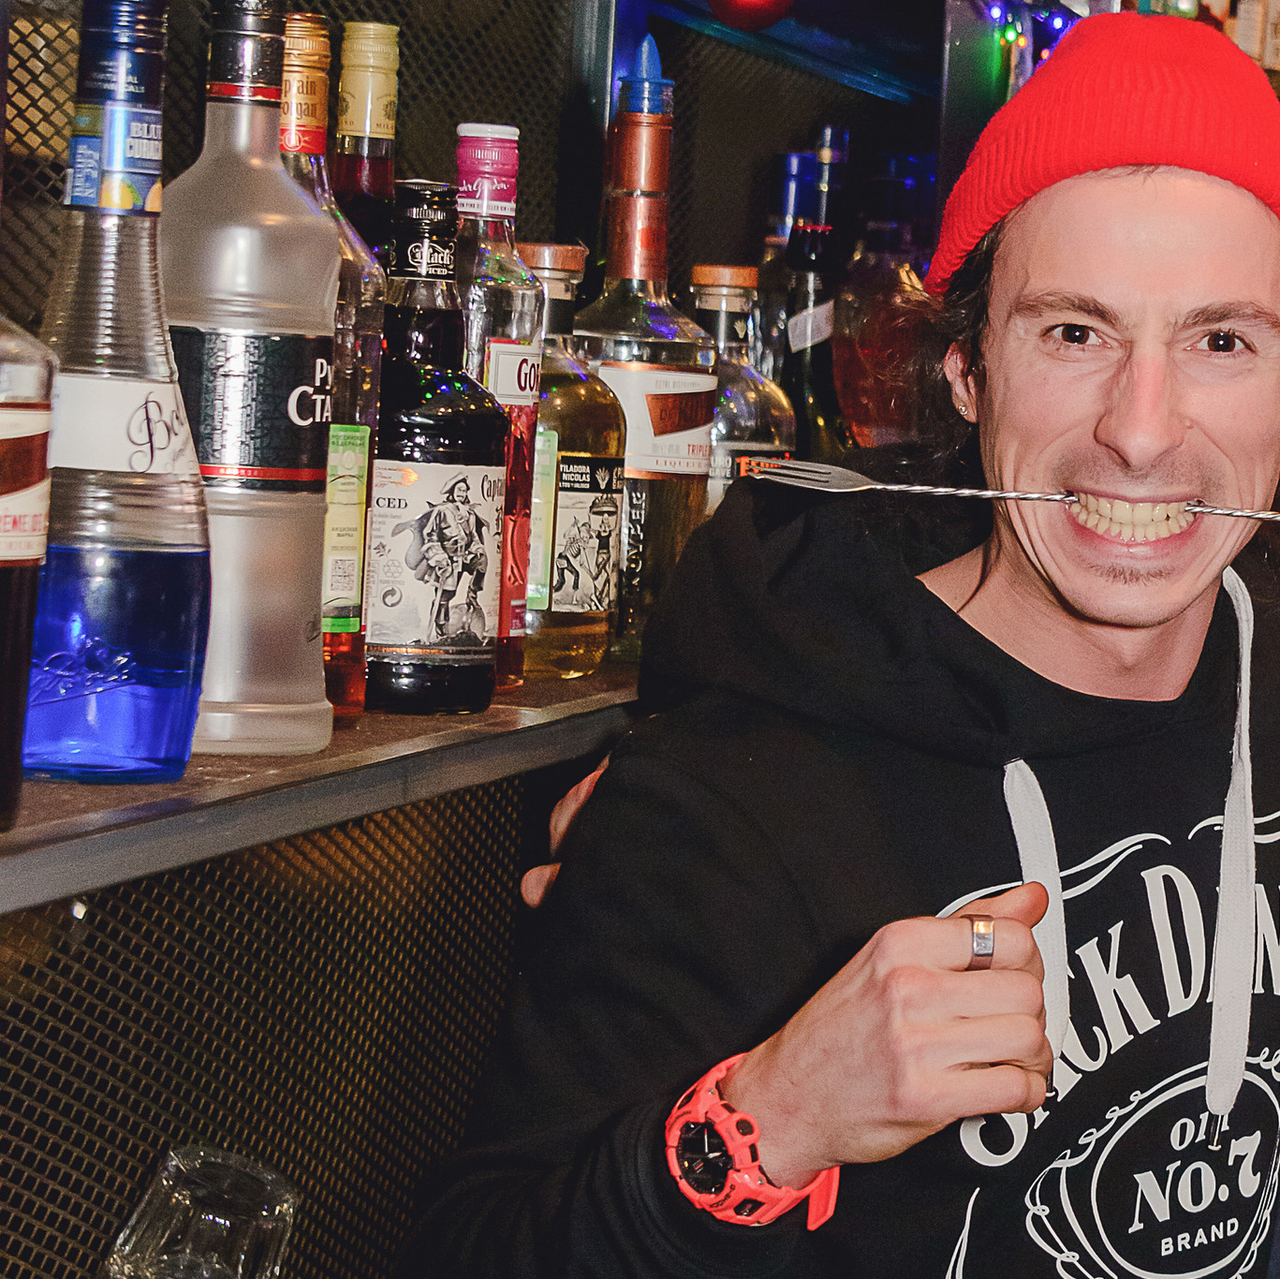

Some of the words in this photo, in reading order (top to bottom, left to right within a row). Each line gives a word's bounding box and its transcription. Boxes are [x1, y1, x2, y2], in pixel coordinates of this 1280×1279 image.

[473, 178, 510, 198] Gdon
[417, 266, 448, 276] ICED
[1161, 1217, 1239, 1257] BRAND
